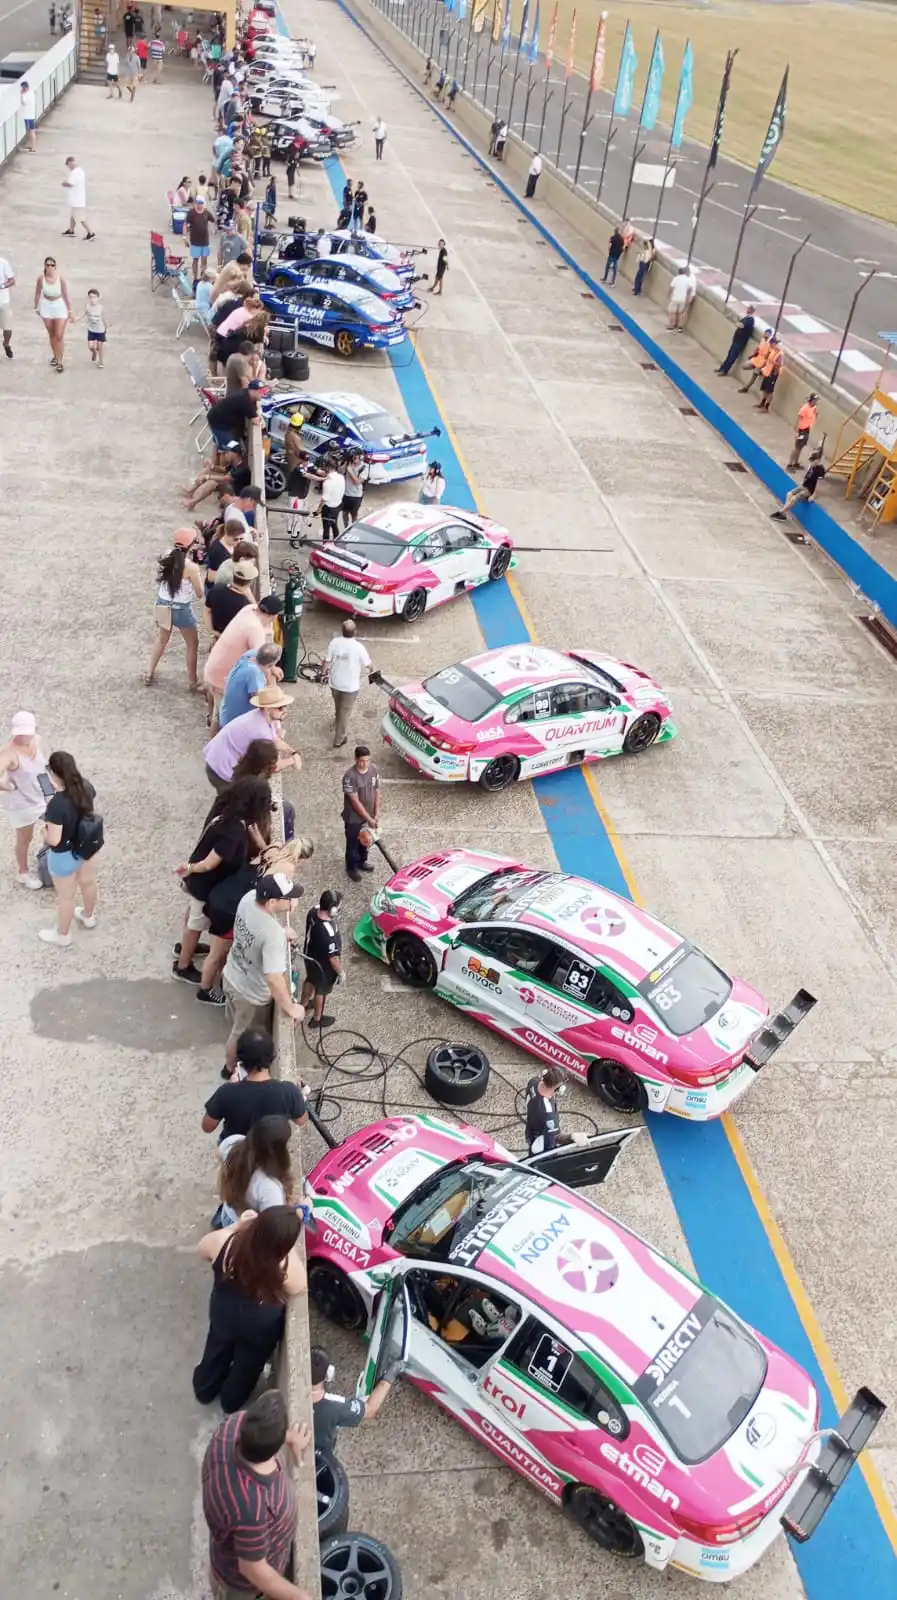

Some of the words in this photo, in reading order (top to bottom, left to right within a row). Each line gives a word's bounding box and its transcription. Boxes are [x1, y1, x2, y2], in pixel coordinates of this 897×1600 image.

[535, 699, 549, 709] 99
[545, 716, 617, 740] QUANTIUM
[461, 966, 503, 995] envaco
[568, 970, 589, 989] 83
[655, 985, 682, 1011] 83
[525, 1030, 586, 1072] QUANTIUM
[611, 1026, 669, 1064] etman
[324, 1209, 361, 1239] VENTURINO
[459, 1177, 553, 1267] RENAULT
[520, 1213, 570, 1265] AXION
[546, 1355, 558, 1373] 1
[645, 1312, 703, 1387] DIRECTV
[668, 1394, 692, 1420] 1
[480, 1418, 561, 1492] QUANTIUM
[600, 1443, 681, 1511] etman
